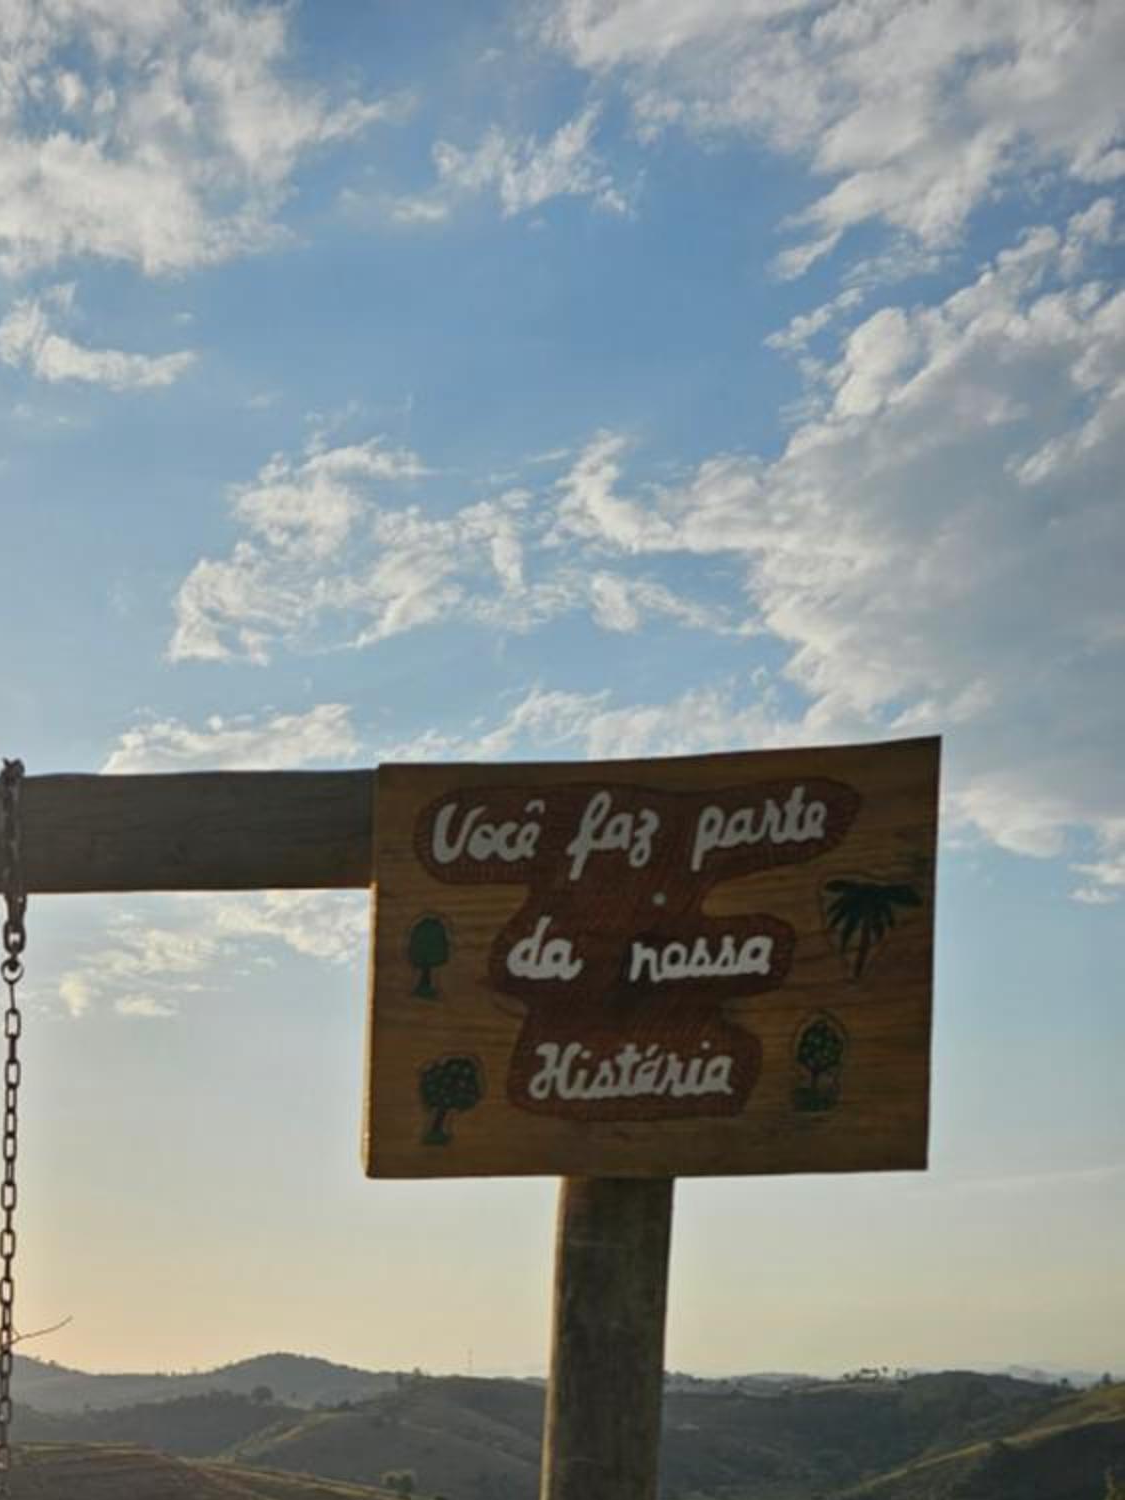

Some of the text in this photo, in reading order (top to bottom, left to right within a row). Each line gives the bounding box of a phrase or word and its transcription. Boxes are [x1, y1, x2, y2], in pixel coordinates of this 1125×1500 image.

[432, 787, 826, 880] Você faz parte
[506, 916, 773, 983] da nossa
[528, 1041, 732, 1100] História
